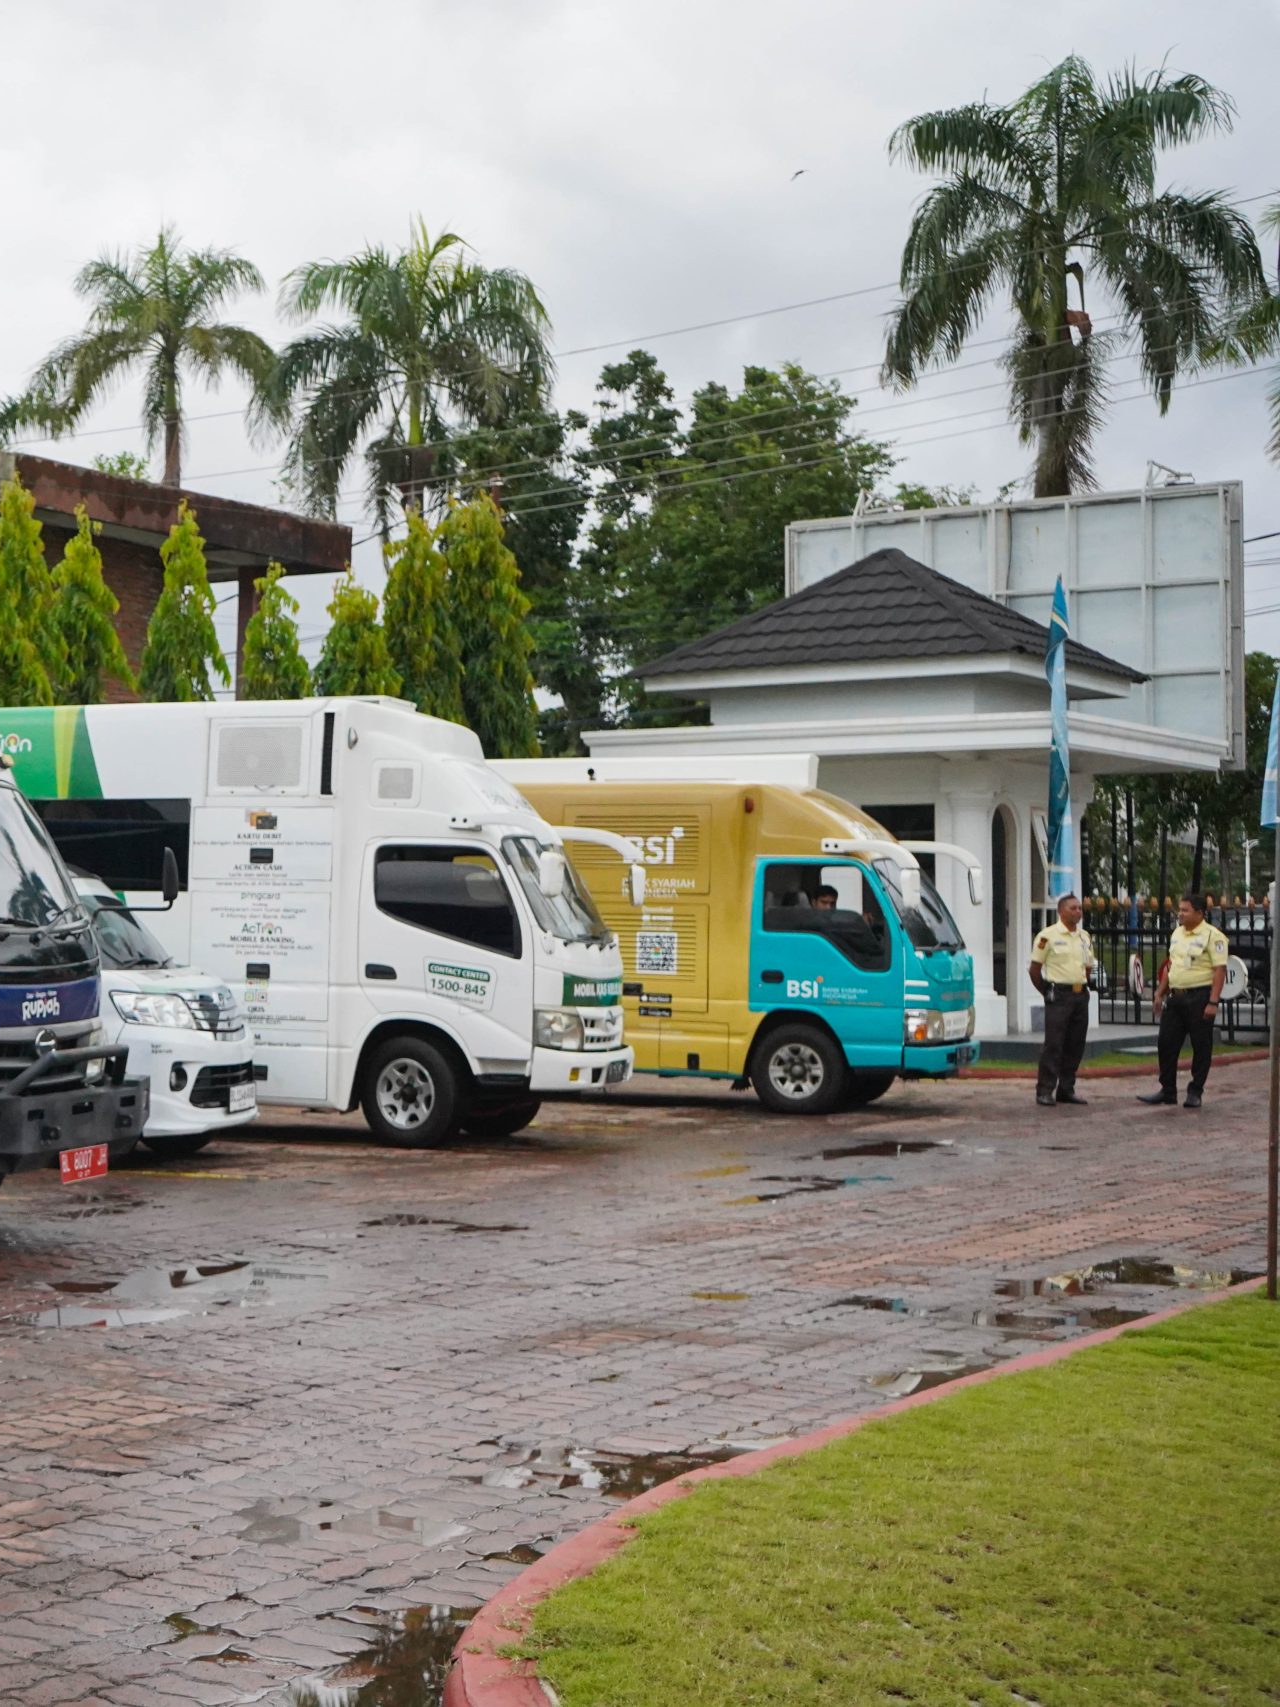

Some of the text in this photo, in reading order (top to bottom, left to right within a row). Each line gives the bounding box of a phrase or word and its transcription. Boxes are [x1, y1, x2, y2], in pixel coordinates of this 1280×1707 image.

[652, 878, 696, 889] SYARIAH
[430, 964, 489, 981] CONTACT CENTER
[431, 978, 487, 996] 1500-845
[573, 983, 596, 998] MOBIL
[786, 979, 819, 999] BSI
